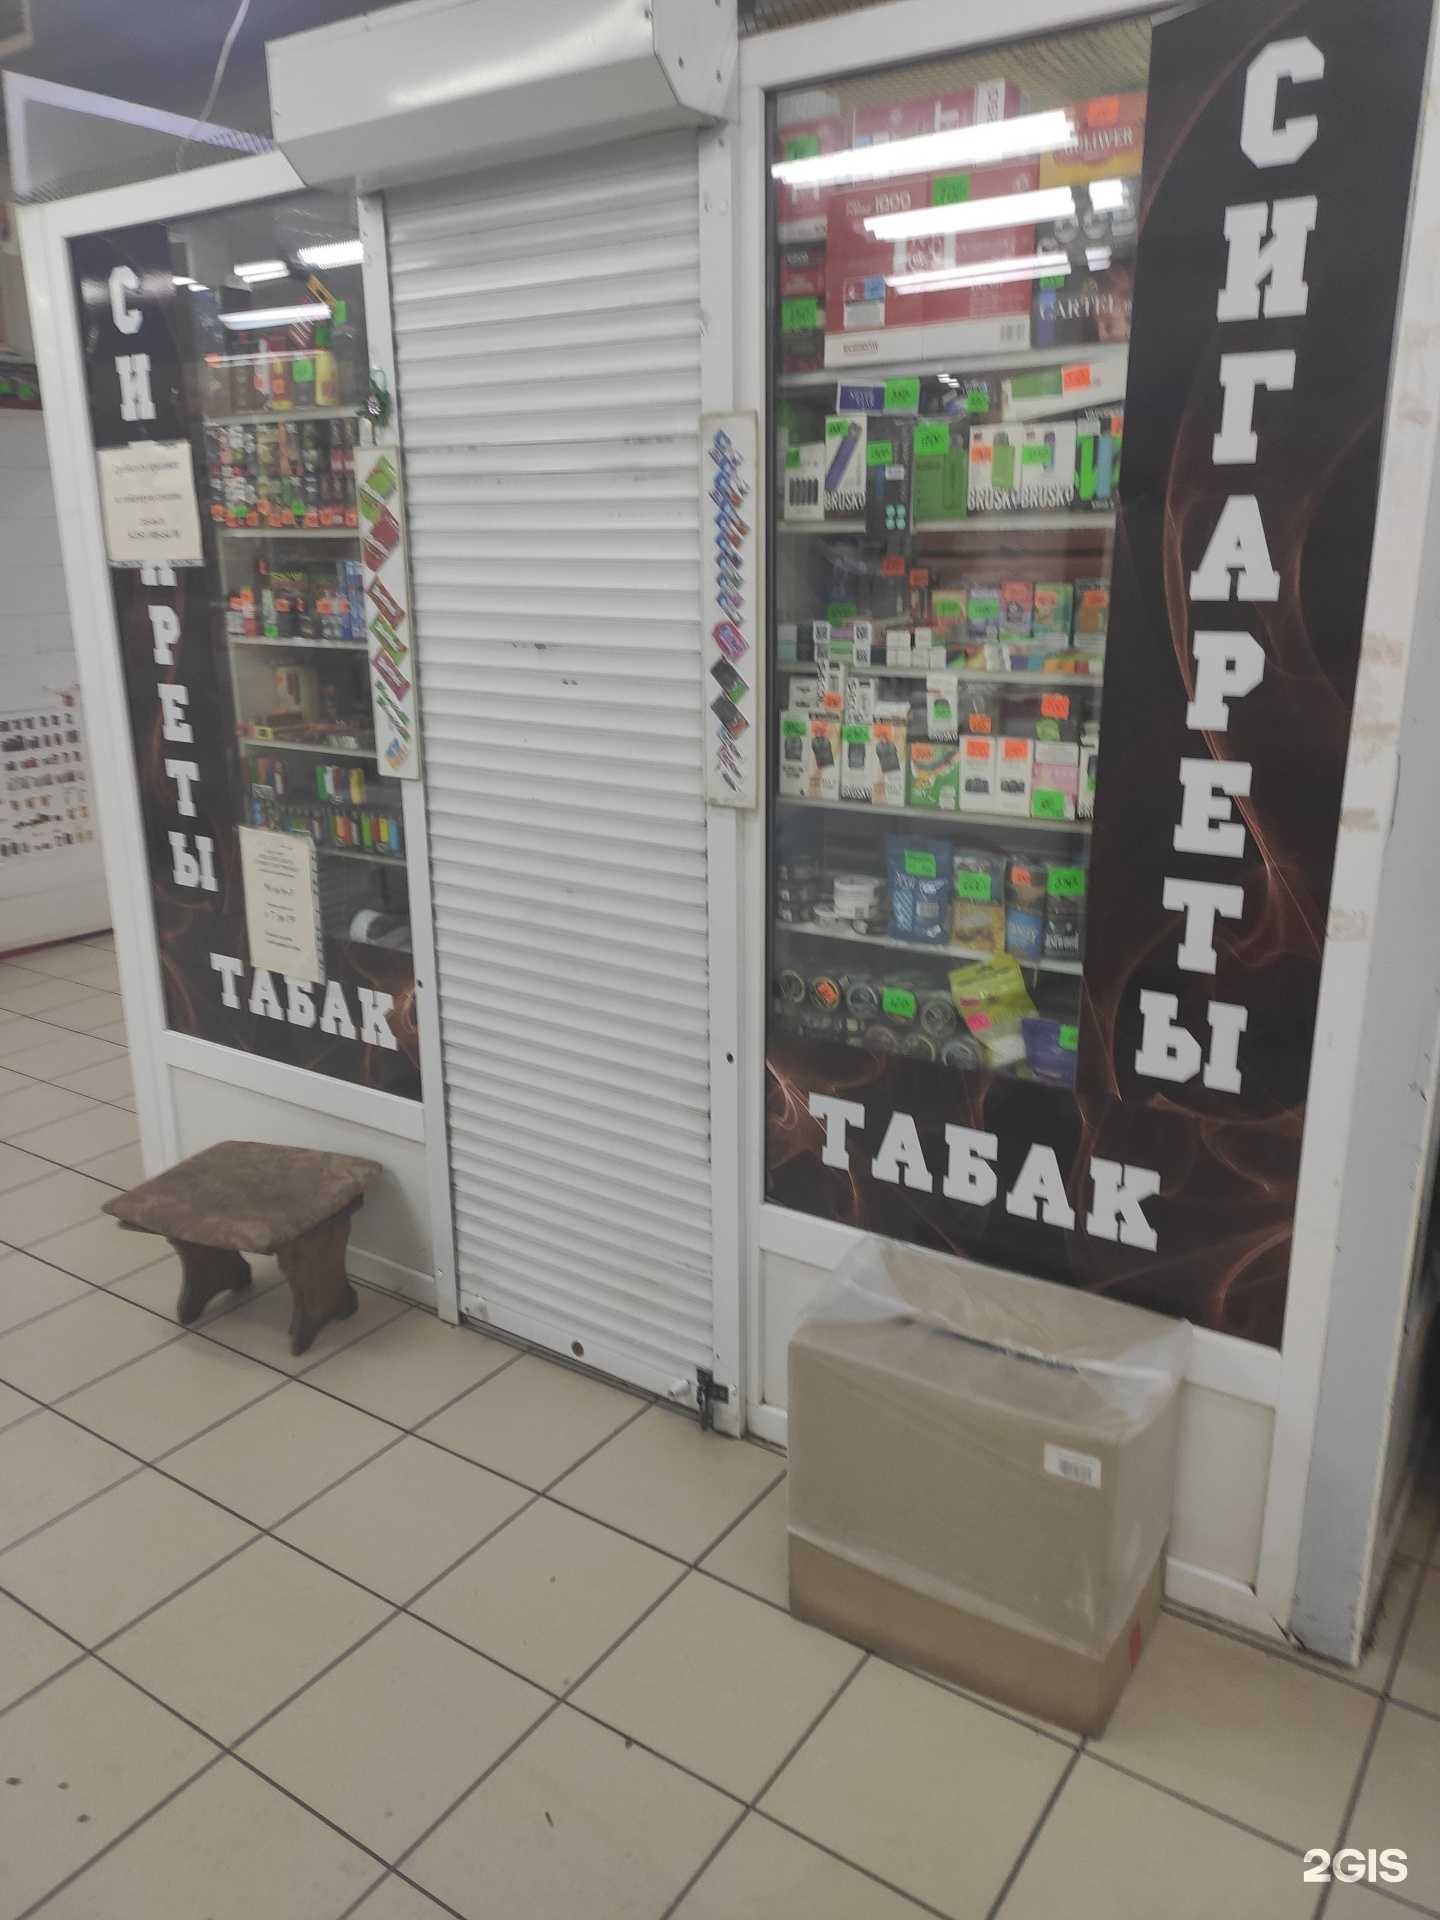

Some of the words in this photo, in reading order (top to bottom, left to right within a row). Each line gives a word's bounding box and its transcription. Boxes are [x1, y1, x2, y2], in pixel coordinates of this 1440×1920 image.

[108, 266, 219, 892] СИРЕТЫ
[1135, 36, 1326, 1094] СИГАРЕТЫ
[209, 952, 399, 1051] ТАБАК
[808, 1091, 1161, 1252] ТАБАК
